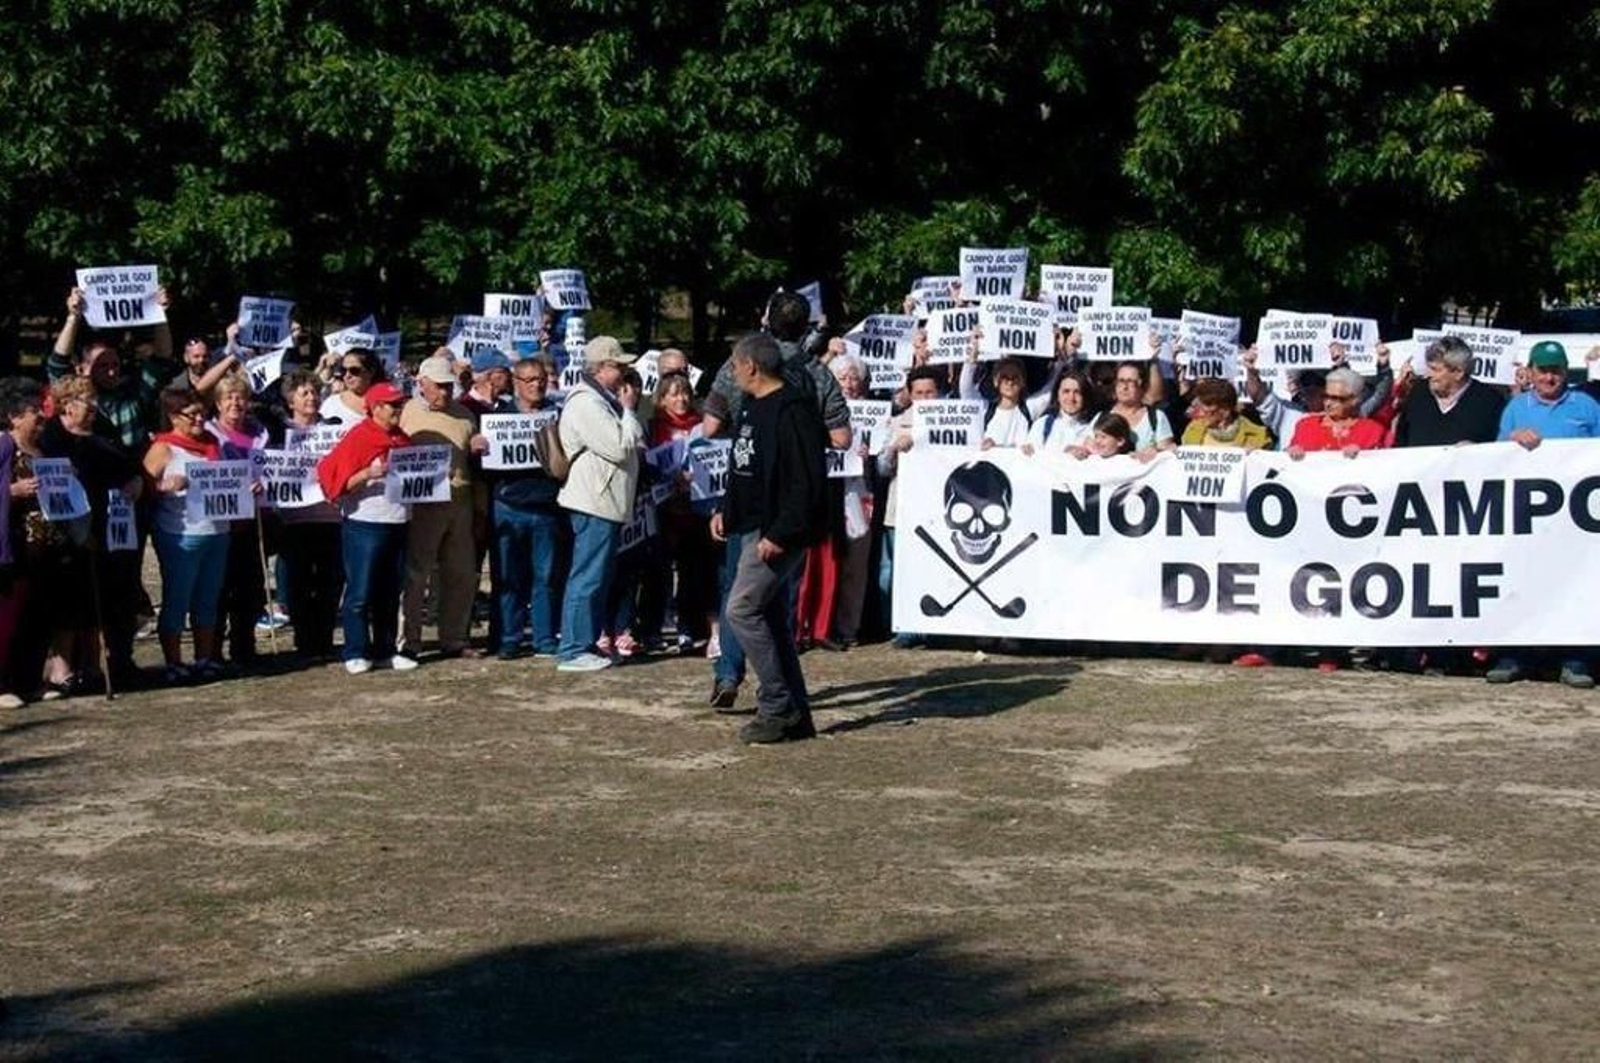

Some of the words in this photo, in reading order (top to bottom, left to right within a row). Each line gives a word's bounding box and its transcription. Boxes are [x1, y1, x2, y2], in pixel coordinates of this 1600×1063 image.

[964, 254, 994, 263] CAMPO
[1045, 271, 1073, 280] CAMPO
[975, 276, 1012, 296] NON
[500, 299, 532, 316] NON
[558, 290, 581, 306] NON
[985, 303, 1016, 313] CAMPO
[1057, 294, 1093, 314] NON
[103, 298, 144, 322] NON
[943, 312, 979, 333] NON
[252, 323, 279, 343] NON
[999, 328, 1037, 350] NON
[860, 338, 896, 360] NON
[1095, 335, 1134, 355] NON
[1274, 344, 1313, 364] NON
[1473, 357, 1497, 378] ON
[866, 406, 888, 416] GOLF
[486, 420, 517, 430] CAMPO
[929, 428, 967, 446] NON
[502, 442, 540, 464] NON
[1175, 450, 1206, 460] CAMPO
[266, 482, 304, 502] NON
[402, 475, 434, 499] NON
[1186, 475, 1225, 497] NON
[204, 494, 239, 516] NON
[1051, 482, 1216, 538] NON
[1246, 468, 1299, 539] Ó
[1162, 562, 1260, 616] DE
[1290, 561, 1503, 619] GOLF
